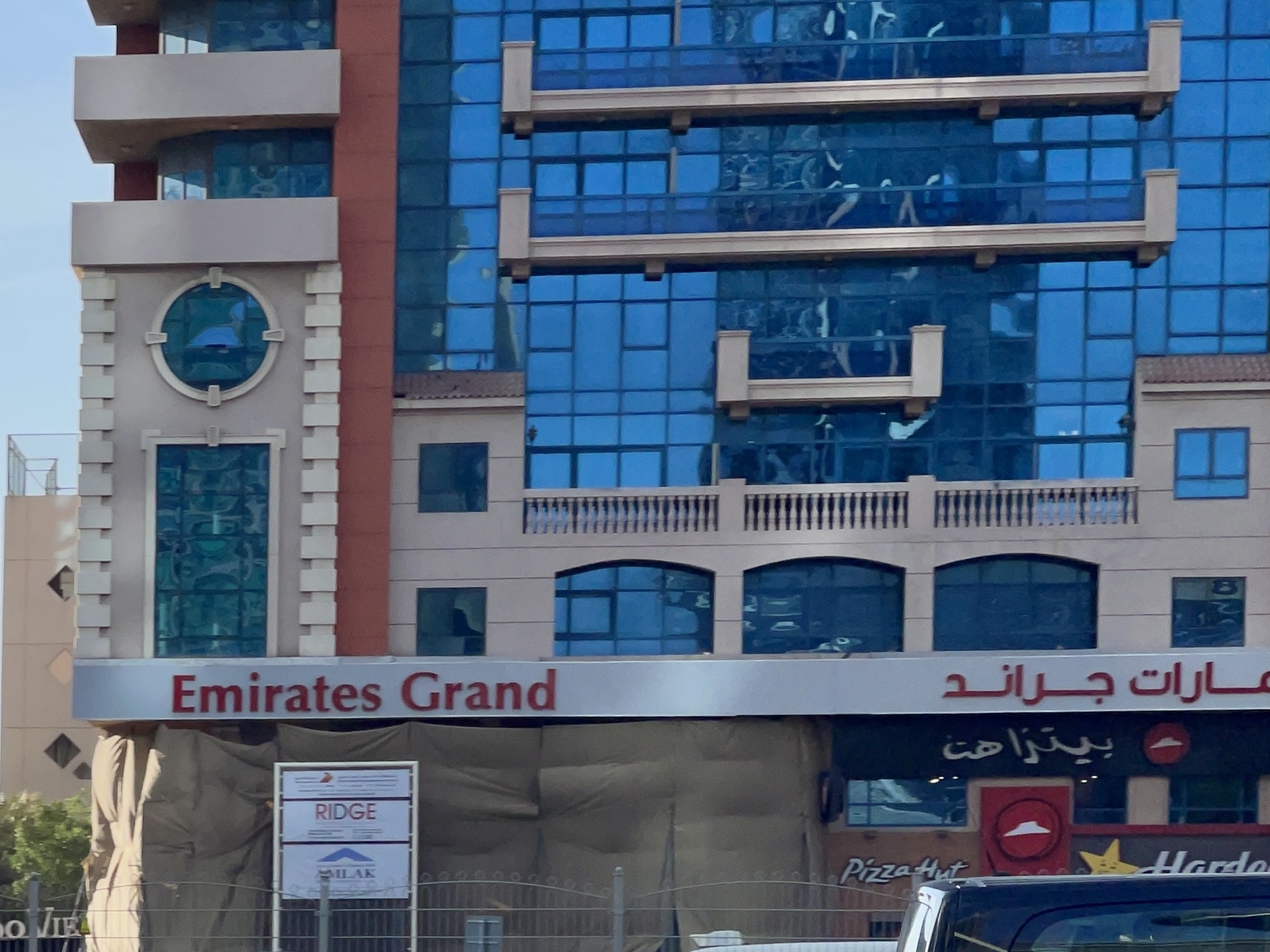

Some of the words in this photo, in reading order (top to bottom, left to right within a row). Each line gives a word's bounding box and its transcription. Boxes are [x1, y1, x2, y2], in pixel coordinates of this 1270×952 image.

[172, 671, 382, 713] Emirates
[401, 668, 557, 712] Grand
[942, 664, 1115, 706] جراند
[942, 734, 1003, 760] هت
[1007, 726, 1114, 765] بيتزا
[315, 803, 377, 820] RIDGE
[839, 857, 911, 885] Pizza
[914, 856, 969, 880] Hut
[1136, 851, 1270, 874] Harde
